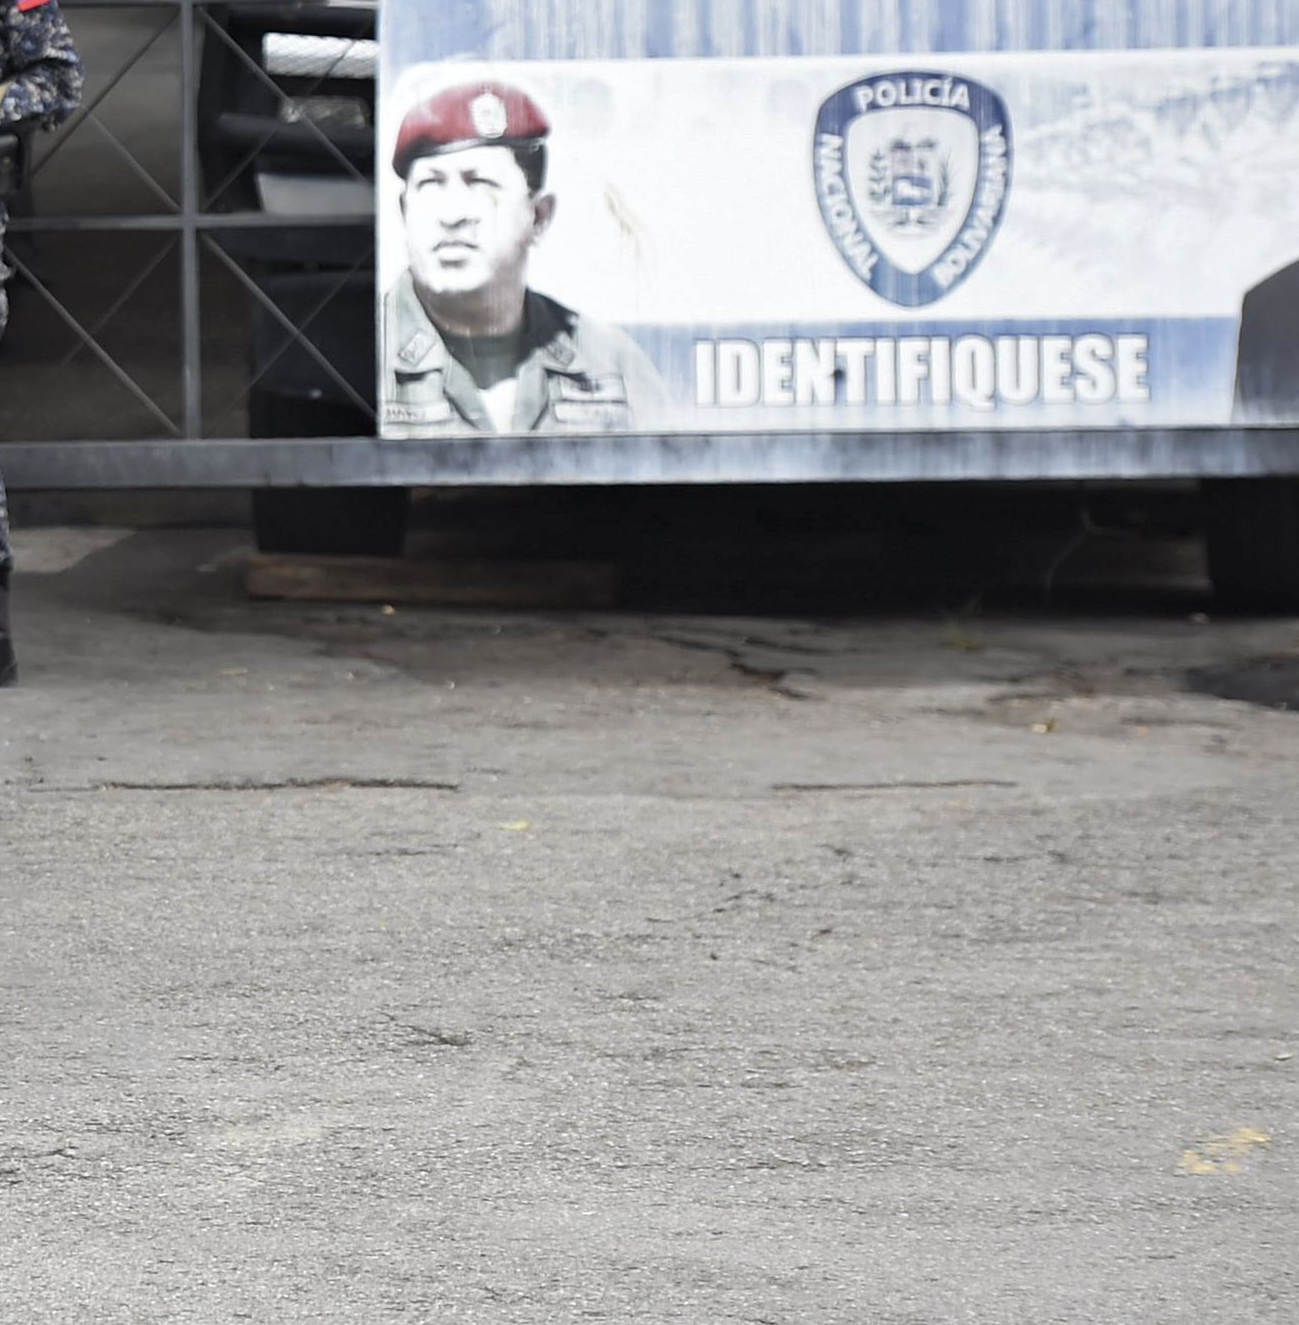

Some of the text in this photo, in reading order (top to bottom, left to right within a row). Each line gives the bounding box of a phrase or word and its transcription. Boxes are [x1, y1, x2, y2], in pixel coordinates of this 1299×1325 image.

[855, 77, 972, 113] POLICÍA
[815, 132, 879, 281] NACIONAL
[694, 332, 1150, 412] IDENTIFIQUESE
